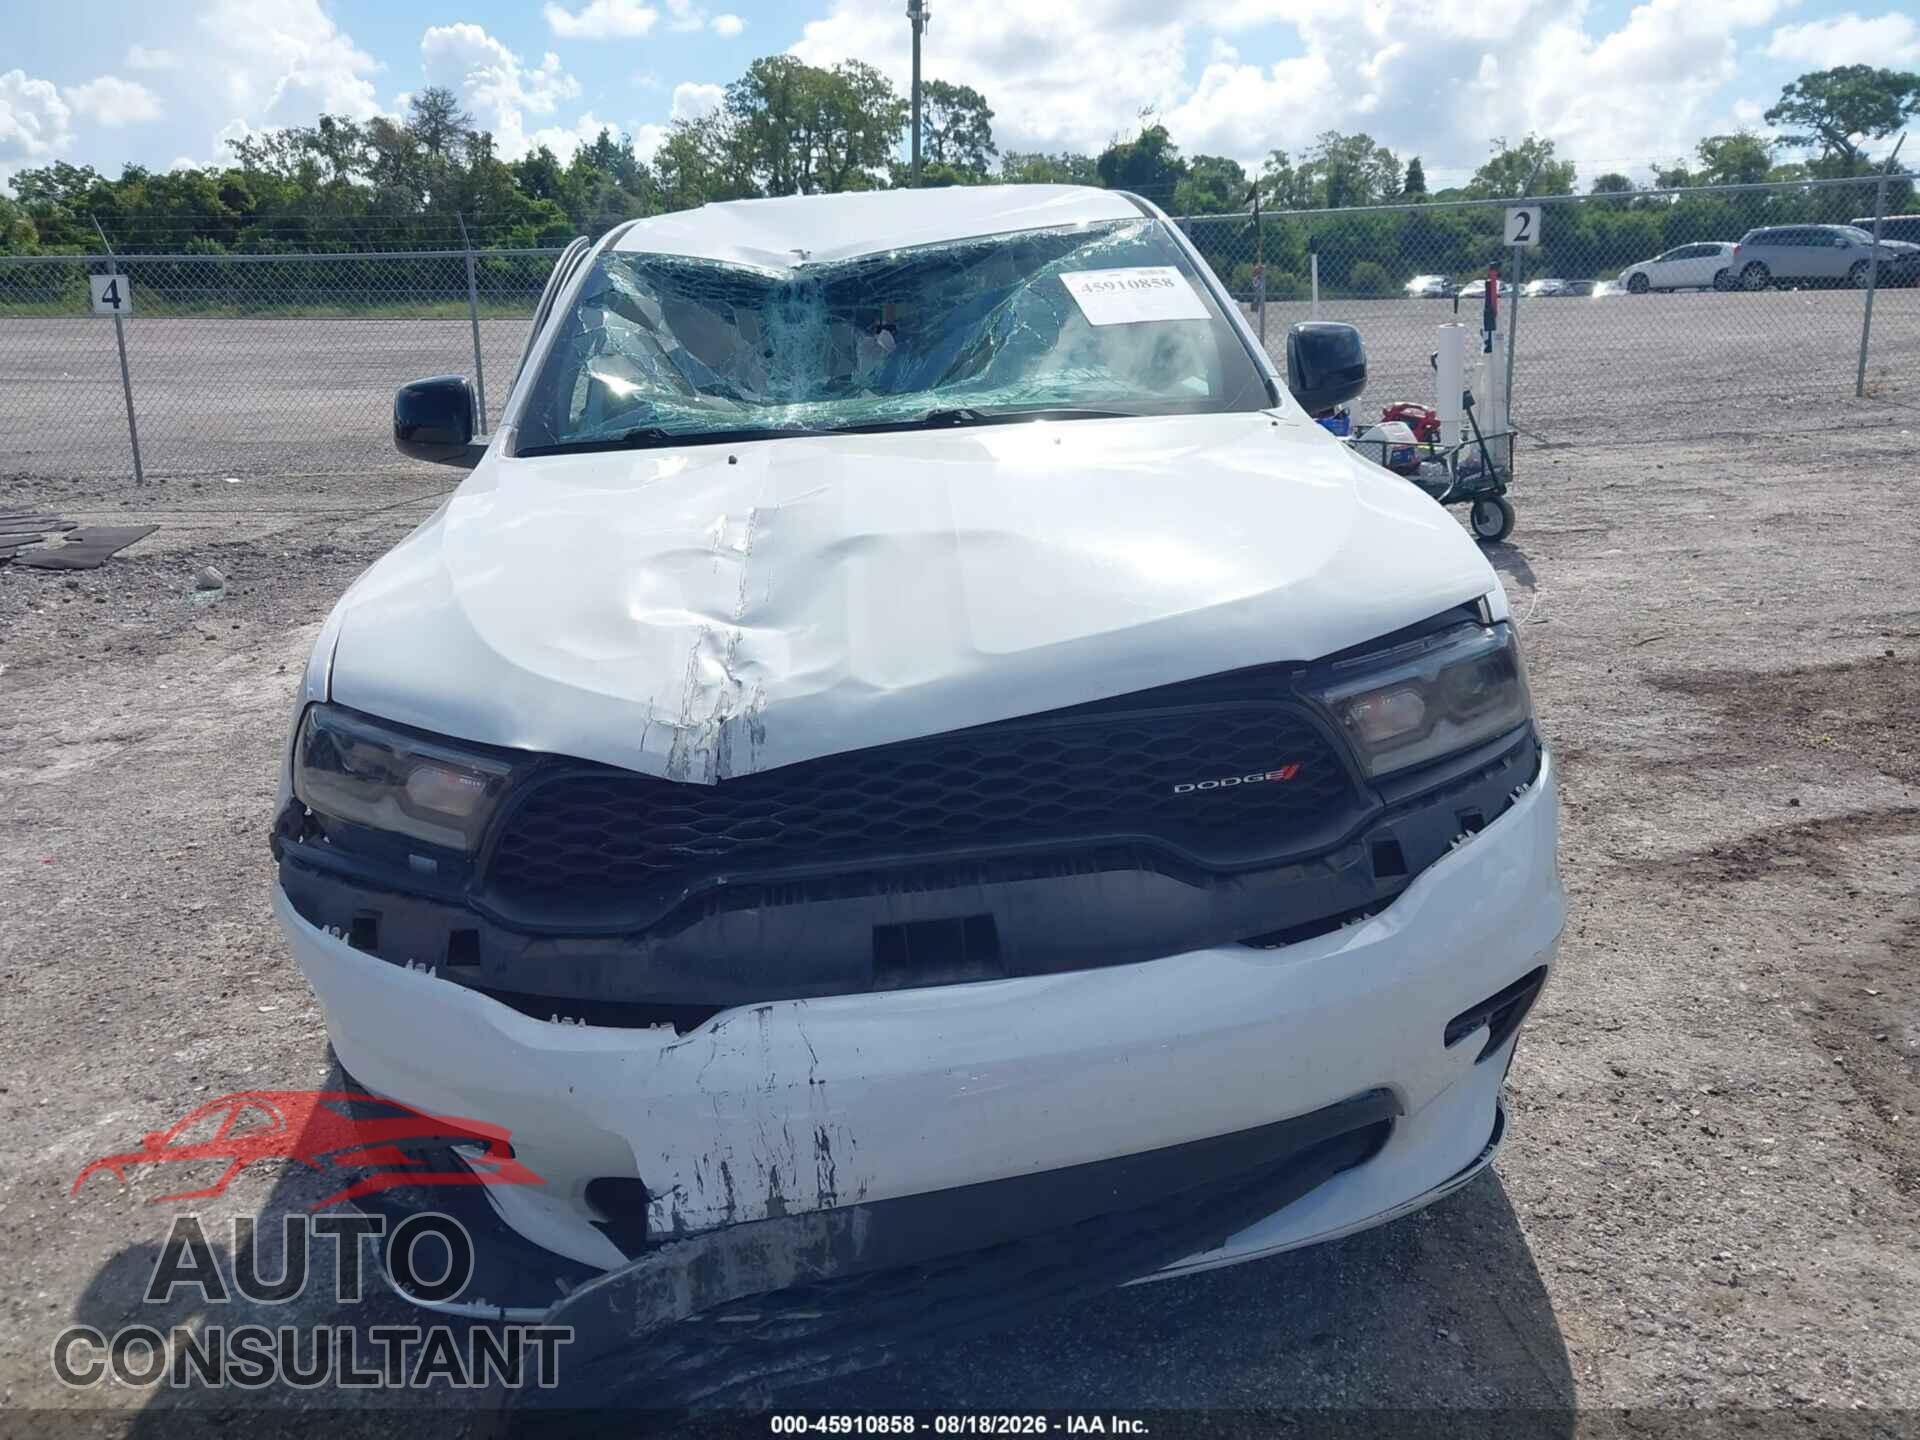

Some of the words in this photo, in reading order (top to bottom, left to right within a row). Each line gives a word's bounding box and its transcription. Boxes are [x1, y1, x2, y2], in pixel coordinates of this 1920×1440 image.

[1513, 211, 1530, 242] 2
[102, 279, 122, 309] 4
[1081, 277, 1175, 294] 45910858
[1174, 769, 1284, 793] DODGE
